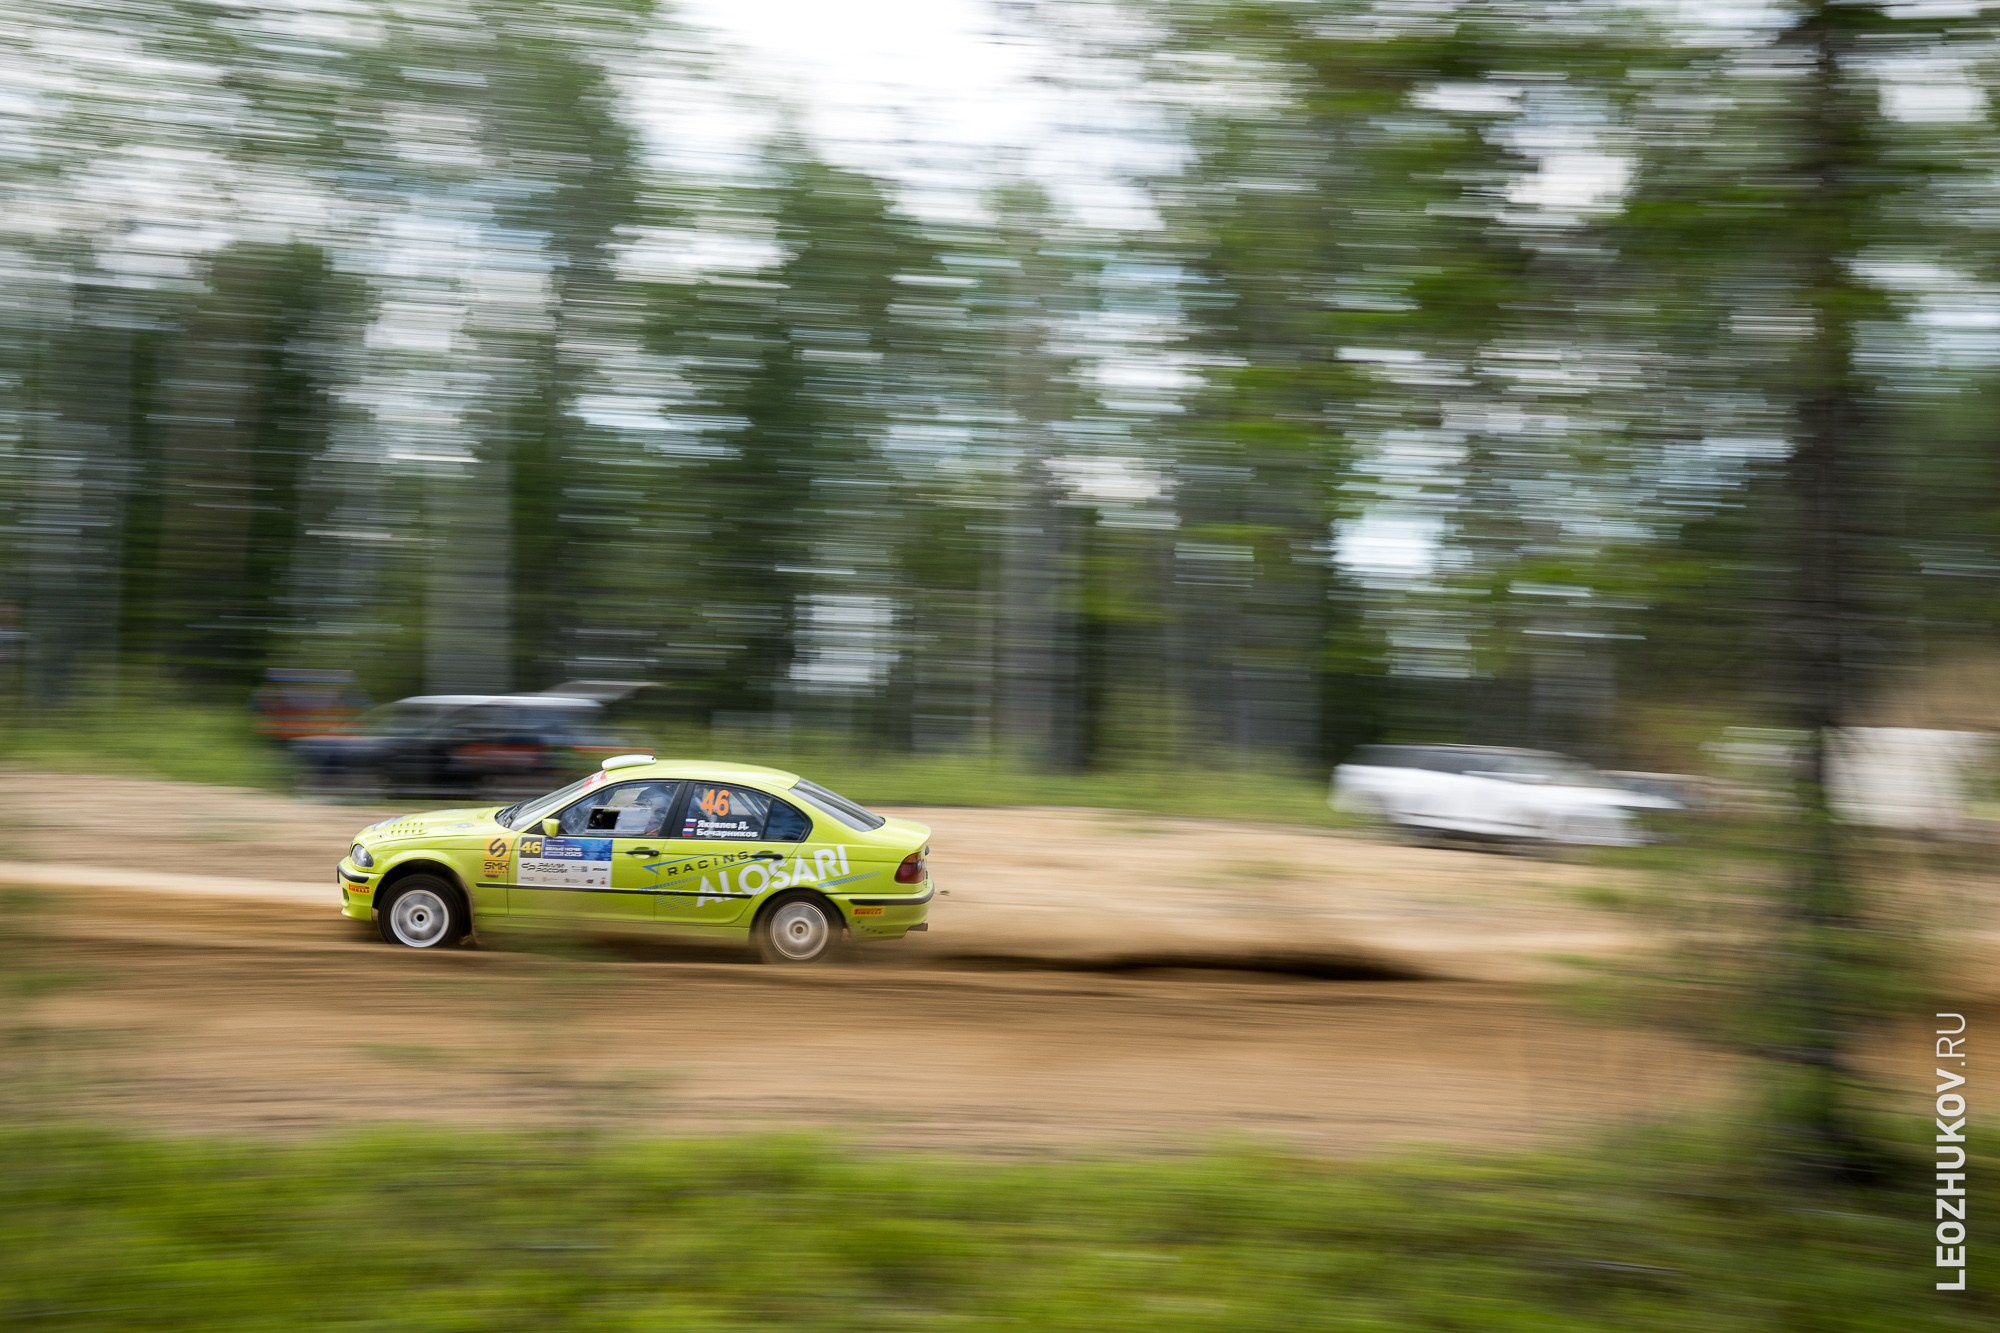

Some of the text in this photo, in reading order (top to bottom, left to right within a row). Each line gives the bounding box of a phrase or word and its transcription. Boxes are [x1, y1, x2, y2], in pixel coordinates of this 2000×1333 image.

[701, 788, 731, 817] 46
[697, 820, 737, 829] Яковлев
[696, 829, 758, 838] Бочарников
[520, 841, 542, 854] 46
[483, 861, 509, 871] SMK
[667, 851, 749, 877] RACING
[696, 846, 850, 907] ALOSARI
